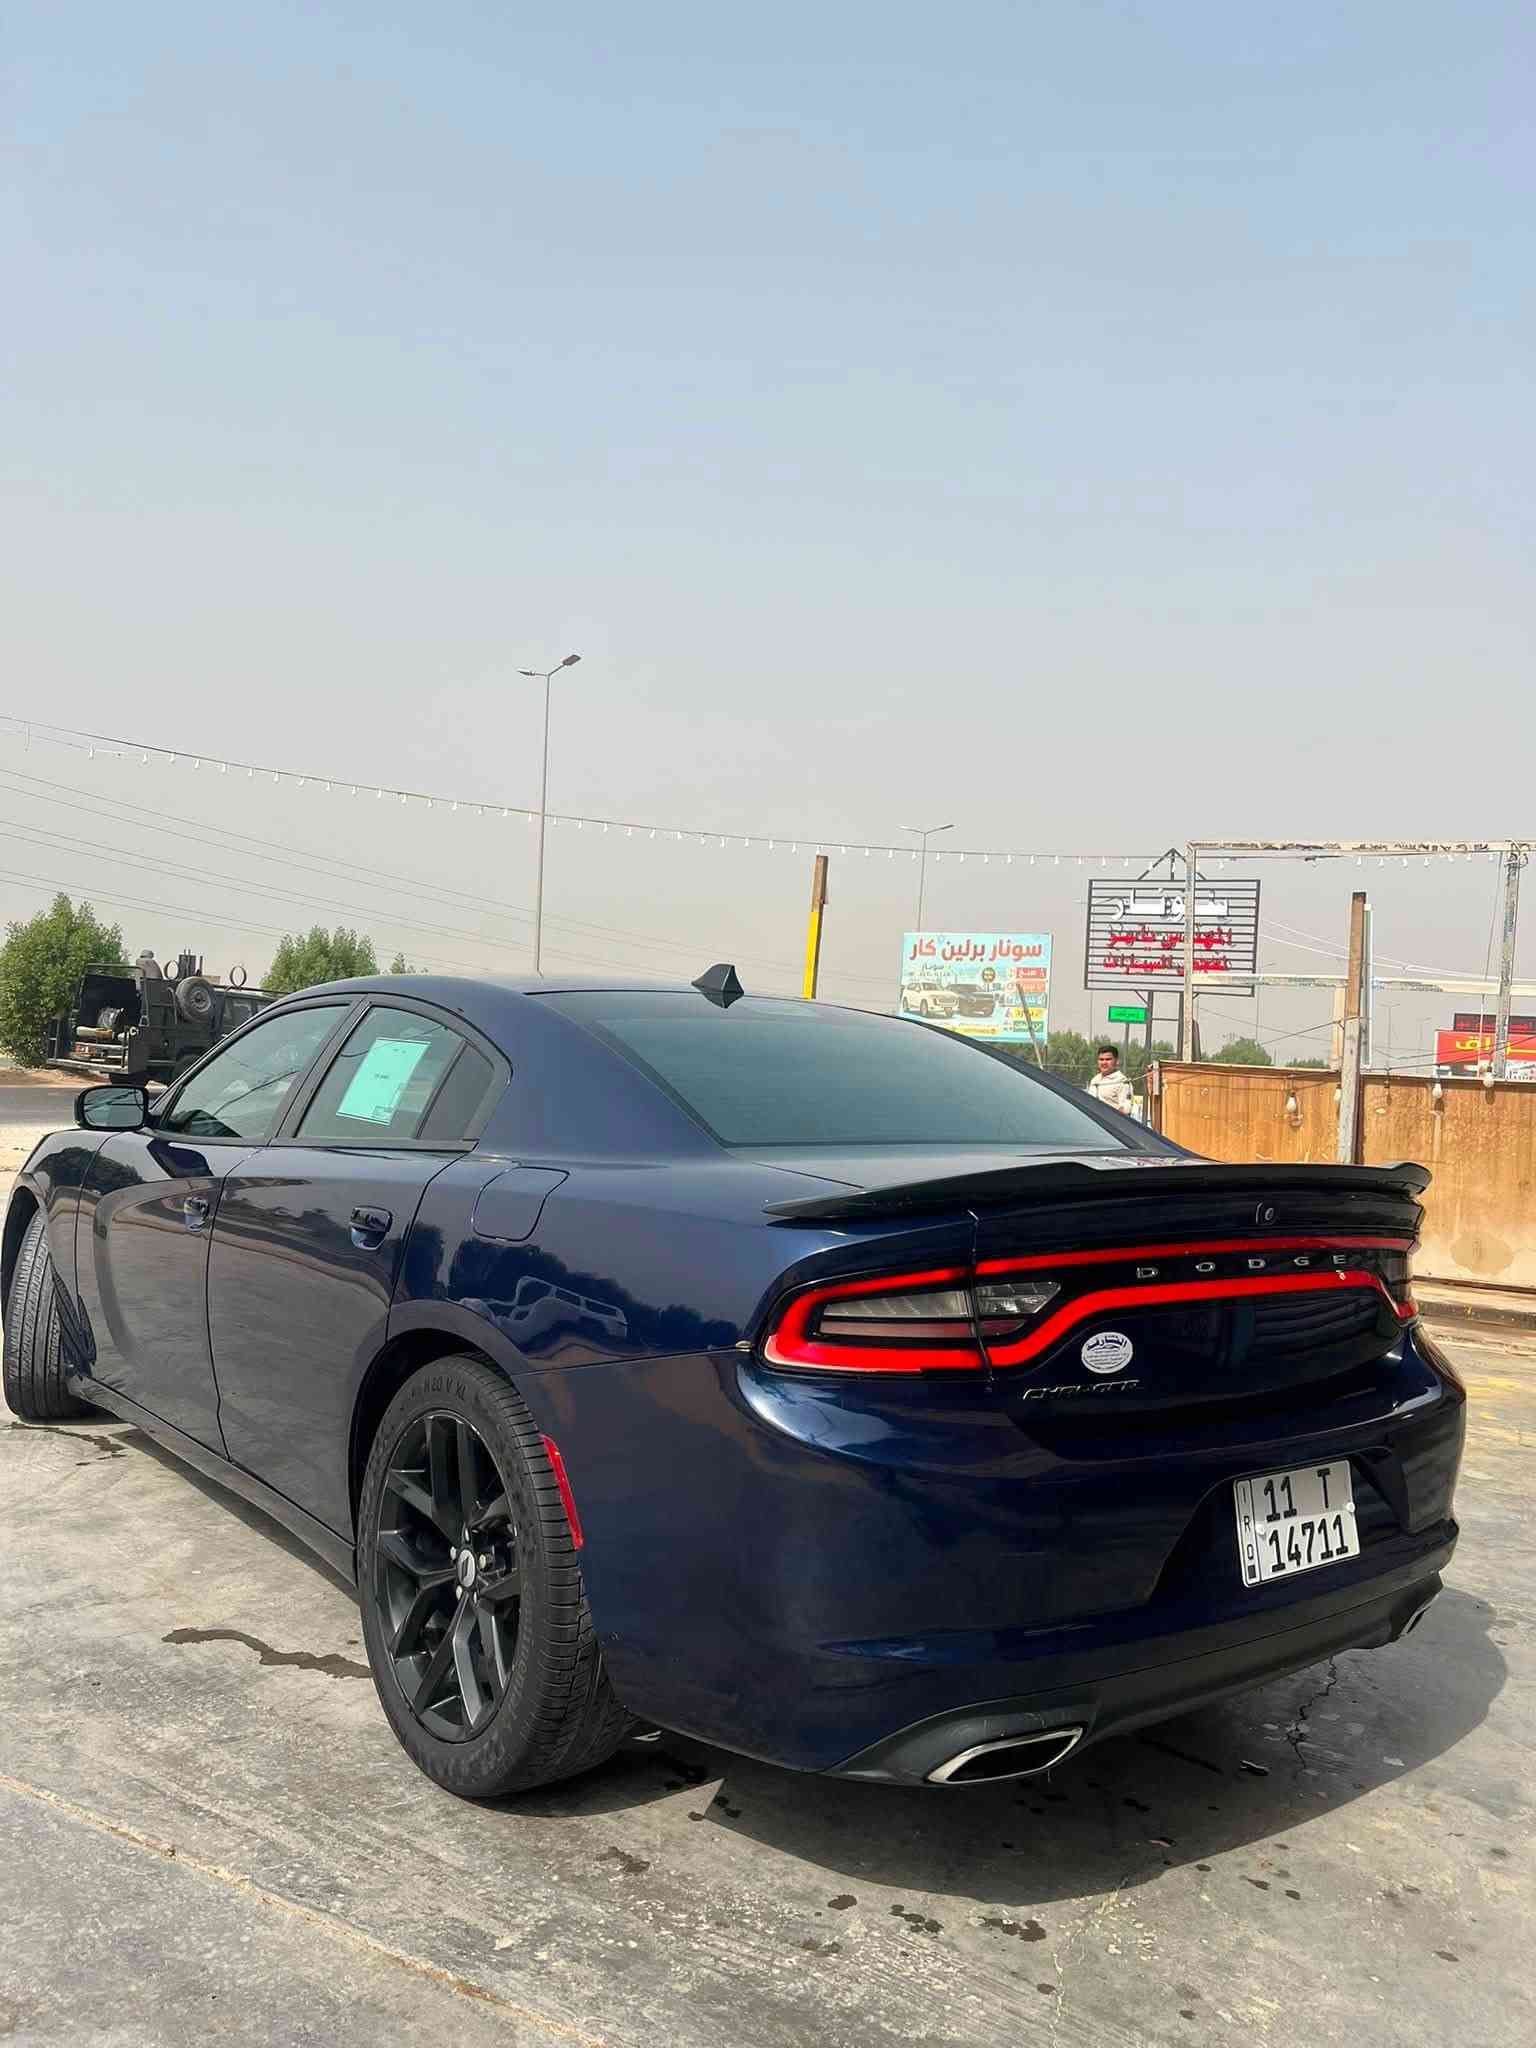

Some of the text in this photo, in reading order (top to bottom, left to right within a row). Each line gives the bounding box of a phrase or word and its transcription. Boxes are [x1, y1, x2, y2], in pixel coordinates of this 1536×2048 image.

[909, 937, 1041, 961] سونار برلين كار
[1136, 1255, 1346, 1279] DODGE
[1264, 1468, 1331, 1523] 11 T
[1269, 1514, 1348, 1573] 14711
